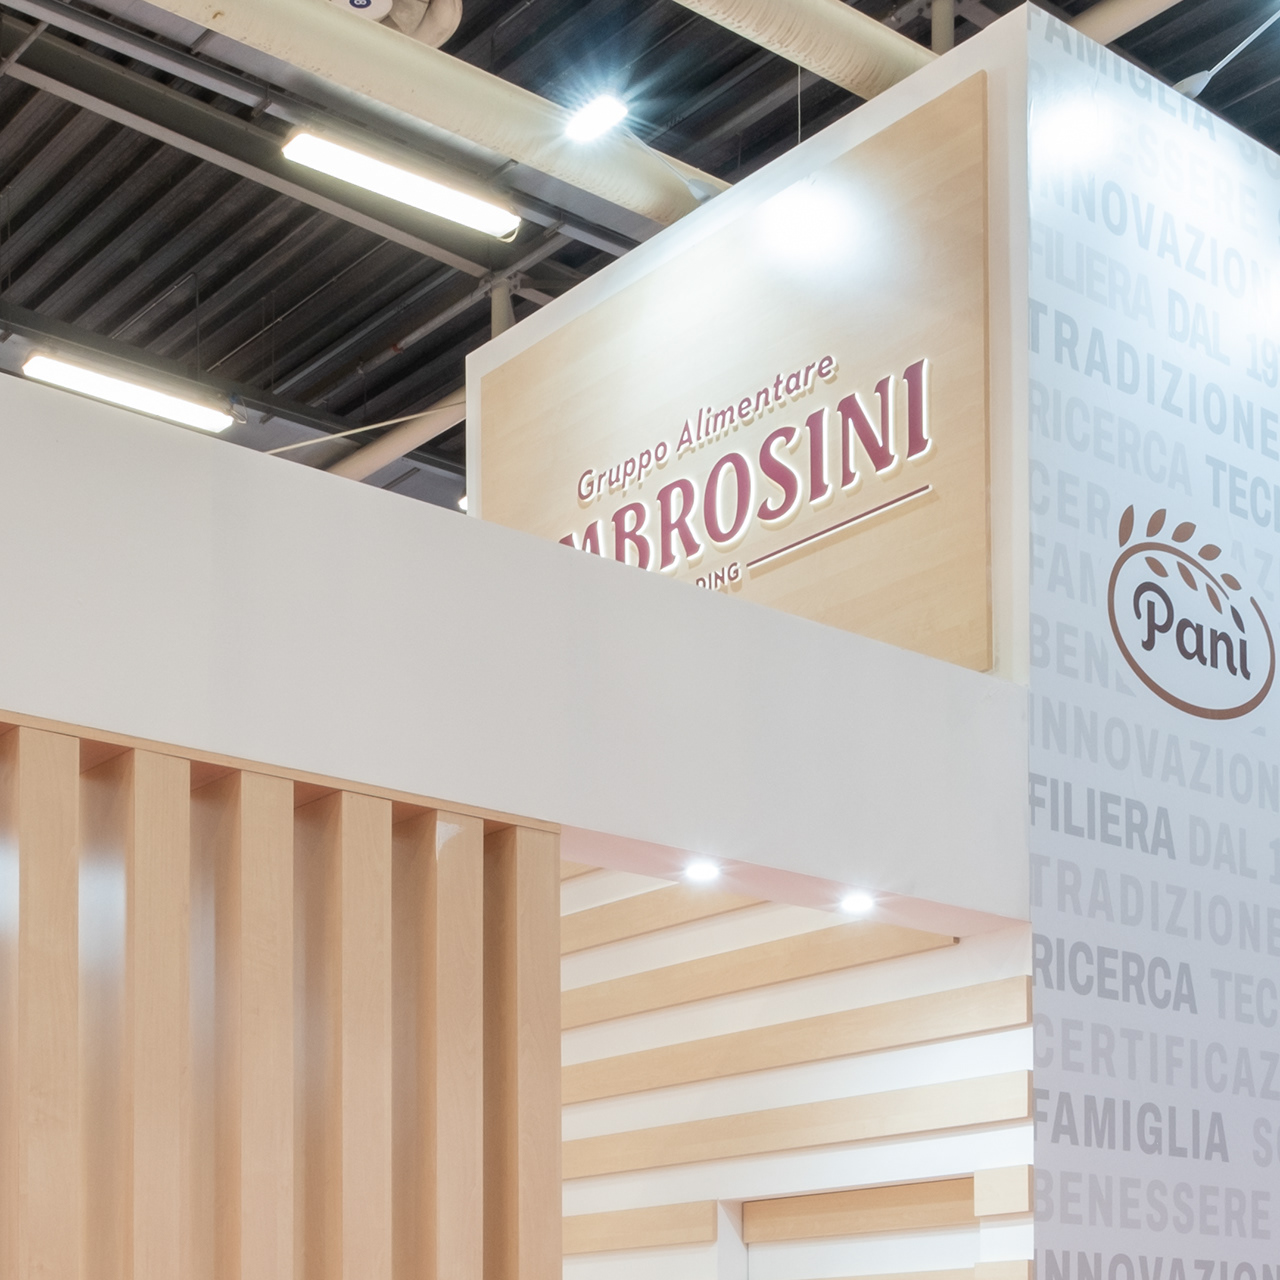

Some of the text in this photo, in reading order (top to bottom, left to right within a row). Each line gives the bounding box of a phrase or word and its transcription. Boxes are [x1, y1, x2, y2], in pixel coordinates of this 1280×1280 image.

[1026, 215, 1156, 332] FILIERA
[1167, 285, 1230, 368] DAL
[577, 355, 835, 501] Gruppo Alimentare
[1027, 295, 1280, 462] TRADIZIONE
[1027, 375, 1192, 499] RICERCA
[1133, 581, 1251, 681] Pani
[1029, 771, 1176, 862] FILIERA
[1188, 814, 1258, 882] DAL
[1030, 931, 1198, 1017] RICERCA
[1031, 1088, 1230, 1165] FAMIGLIA
[1031, 1167, 1272, 1243] BENESSERE
